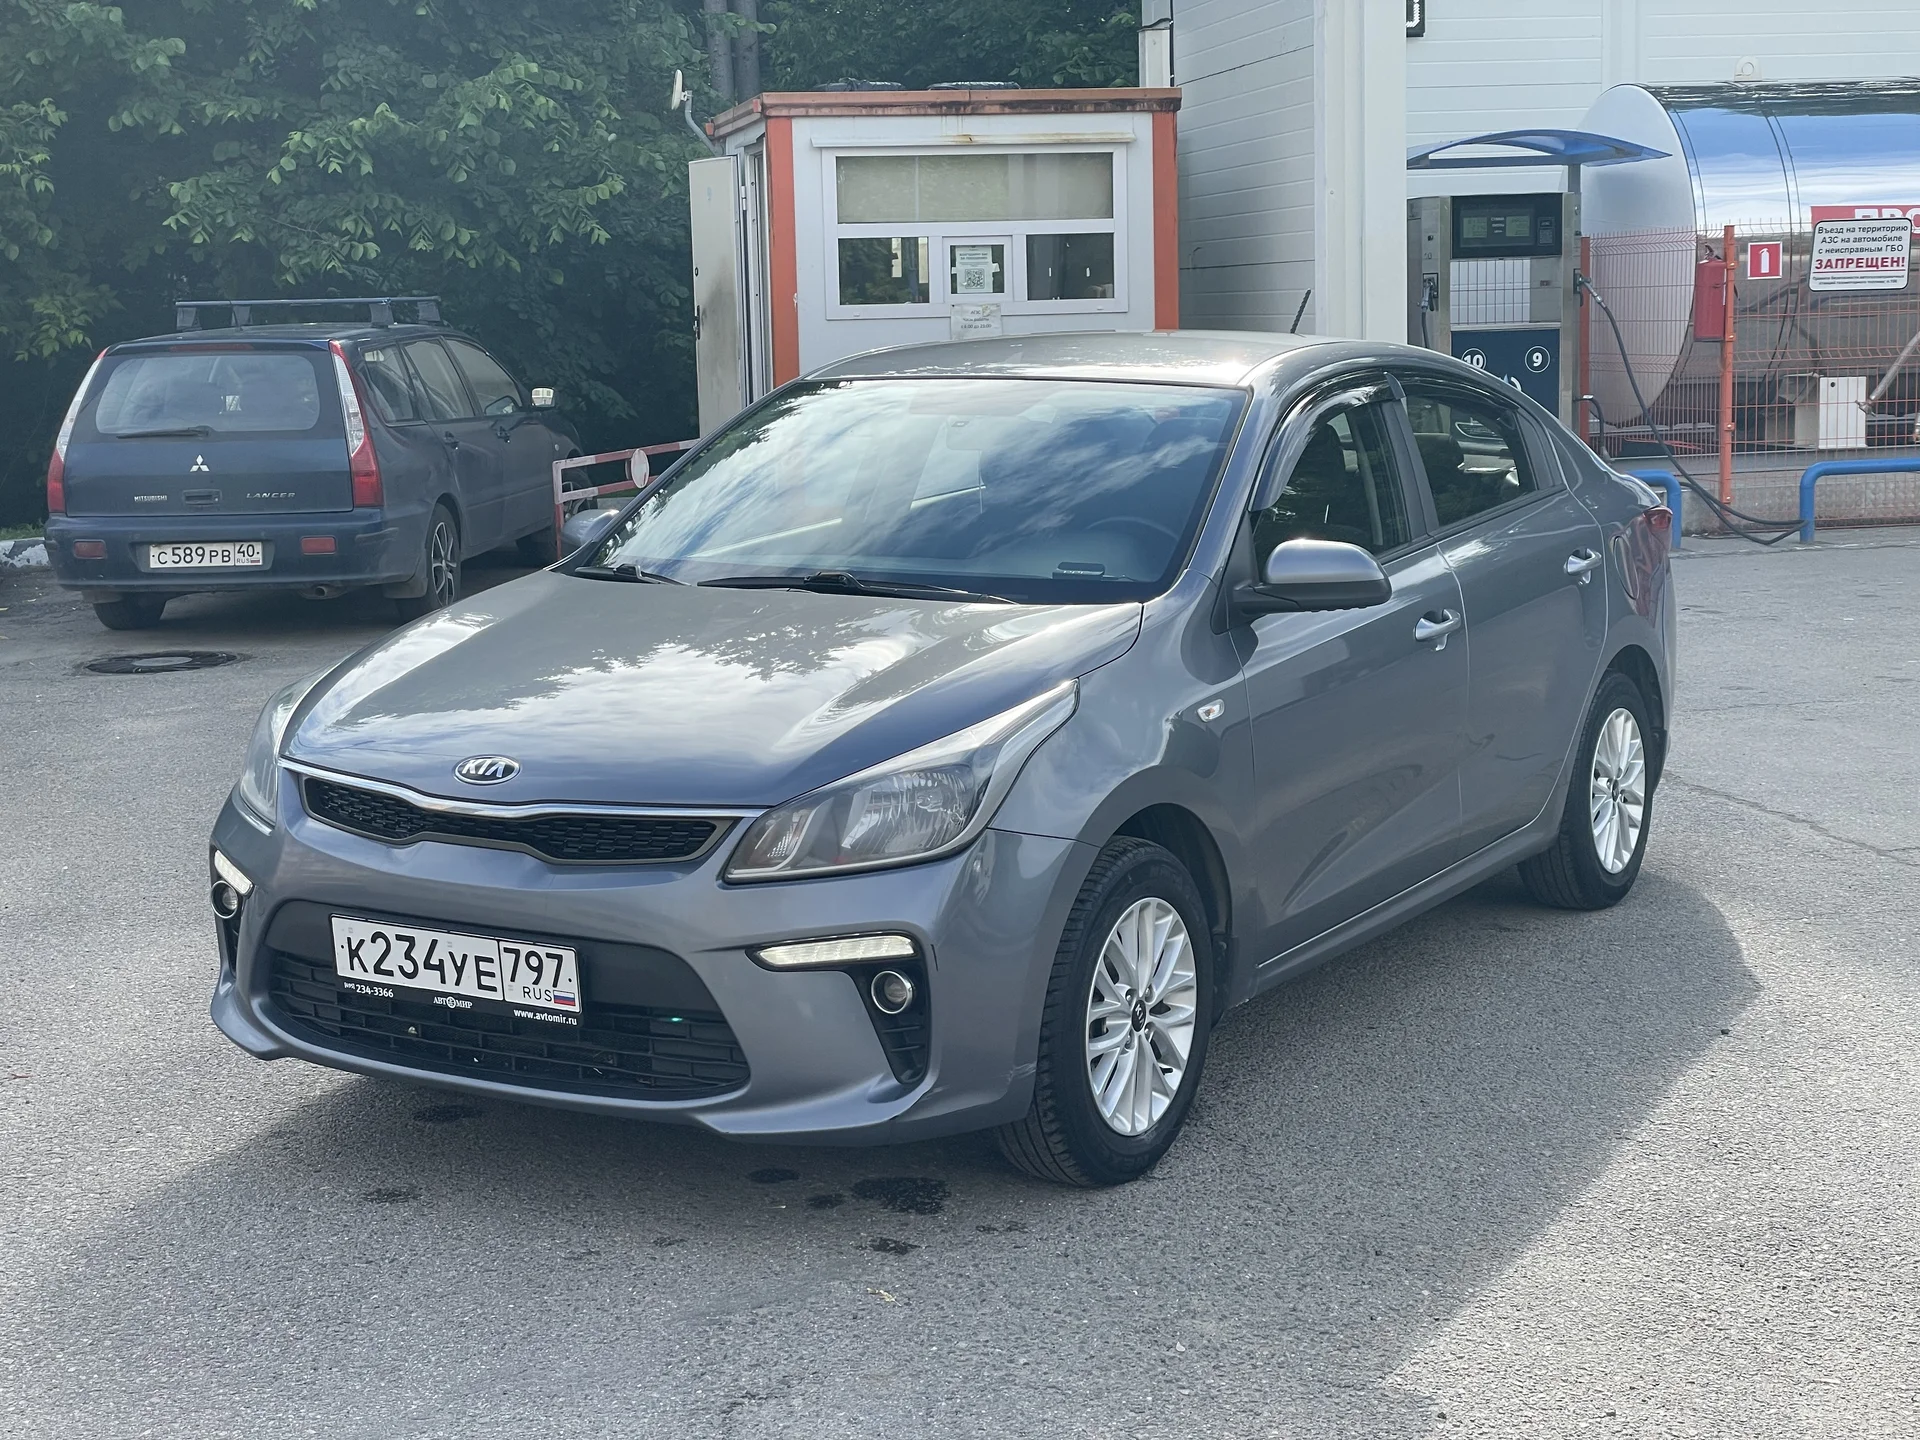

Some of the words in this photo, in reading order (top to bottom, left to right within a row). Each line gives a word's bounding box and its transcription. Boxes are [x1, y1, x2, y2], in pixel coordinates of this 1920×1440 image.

[1817, 226, 1844, 235] Въезд
[1858, 225, 1908, 234] территорию
[1820, 236, 1839, 244] АЗС
[1852, 235, 1903, 243] автомобиле
[1825, 246, 1883, 255] неисправным
[1885, 244, 1904, 252] ГБО
[1815, 256, 1905, 270] ЗАПРЕЩЕН!
[1463, 354, 1484, 369] 10
[1532, 352, 1543, 367] 9
[236, 543, 255, 558] 40
[461, 759, 506, 778] KIA
[503, 947, 564, 988] 797
[355, 984, 394, 998] 234-3366
[522, 986, 553, 1003] RUS
[513, 1009, 578, 1026] www.avtomir.ru
